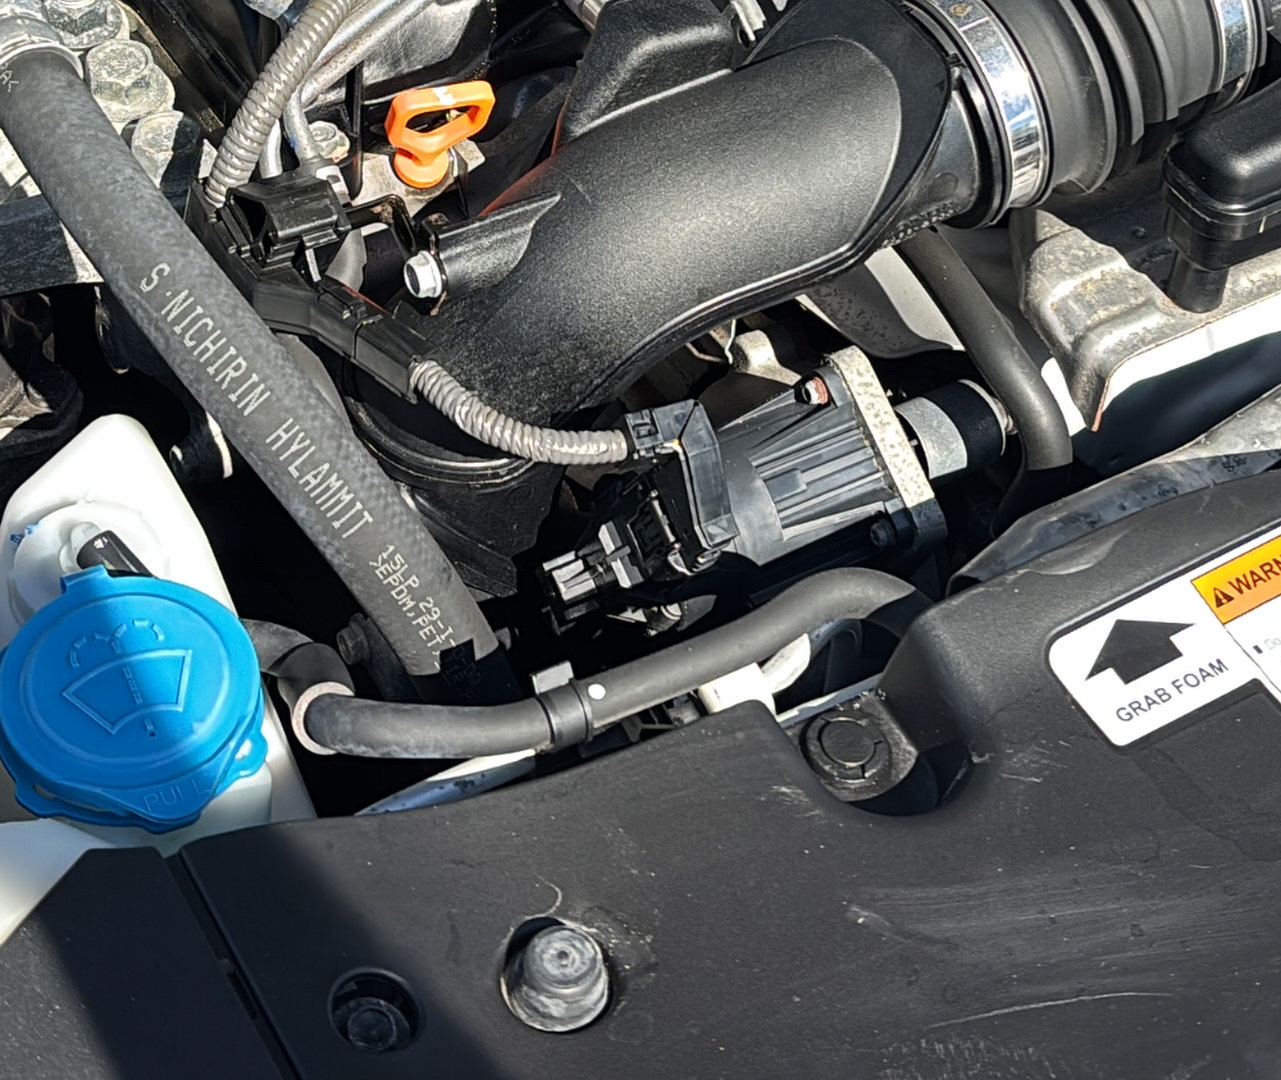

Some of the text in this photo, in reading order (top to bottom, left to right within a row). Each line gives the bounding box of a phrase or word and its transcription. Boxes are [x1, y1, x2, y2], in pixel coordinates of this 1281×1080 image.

[265, 418, 374, 538] HYLAMMIT
[1264, 636, 1281, 651] Do
[1116, 658, 1229, 722] GRAB FOAM
